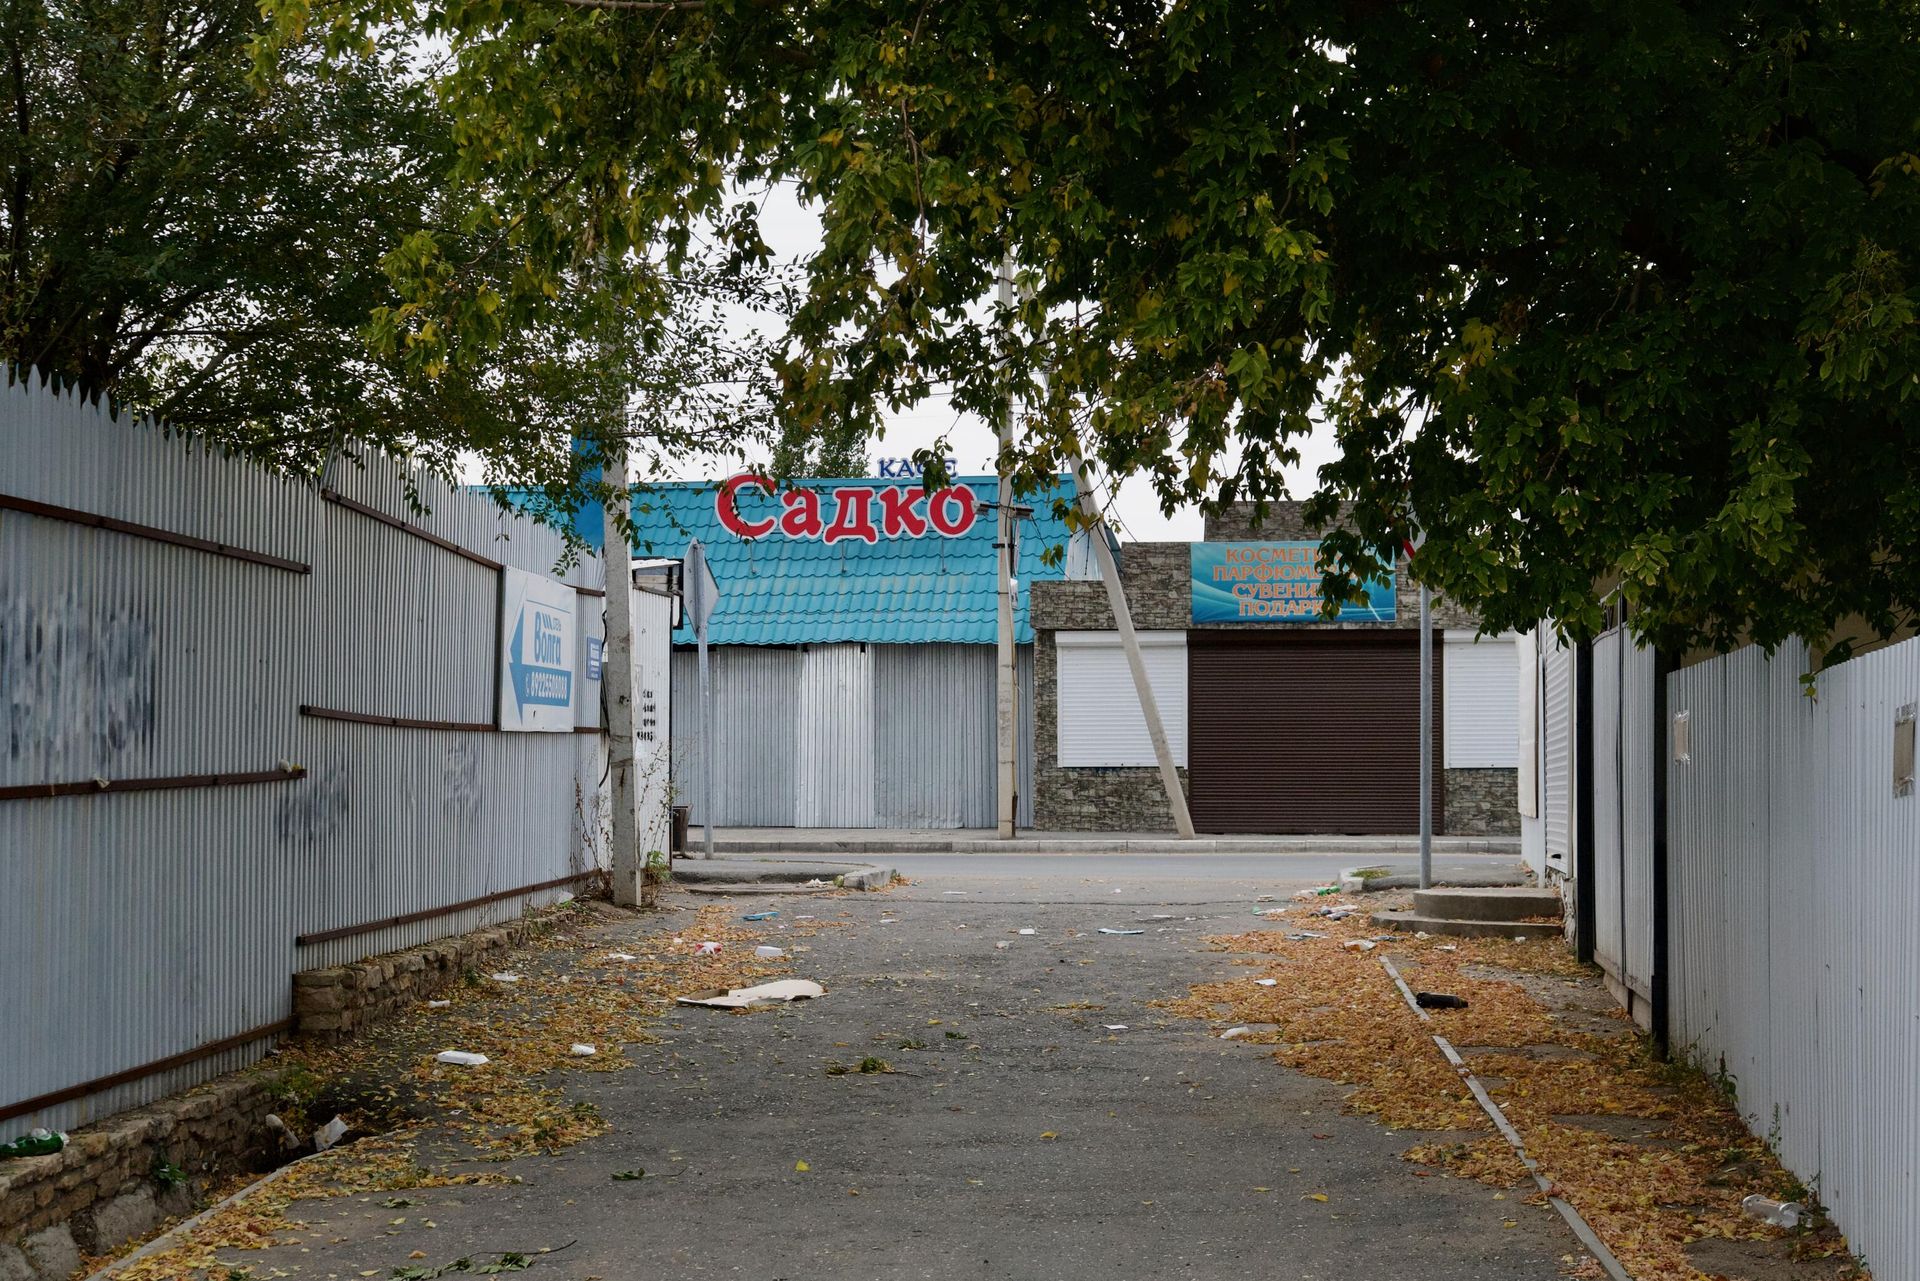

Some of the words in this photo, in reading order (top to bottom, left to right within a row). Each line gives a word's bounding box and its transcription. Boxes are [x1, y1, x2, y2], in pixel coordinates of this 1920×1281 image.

[715, 472, 977, 545] Садко
[1226, 547, 1343, 564] КОСМЕТ
[1212, 563, 1358, 583] ПАРФЮМ
[1231, 582, 1326, 600] СУВЕНИ
[1238, 599, 1327, 618] ПОДАРК
[534, 611, 562, 666] Волга
